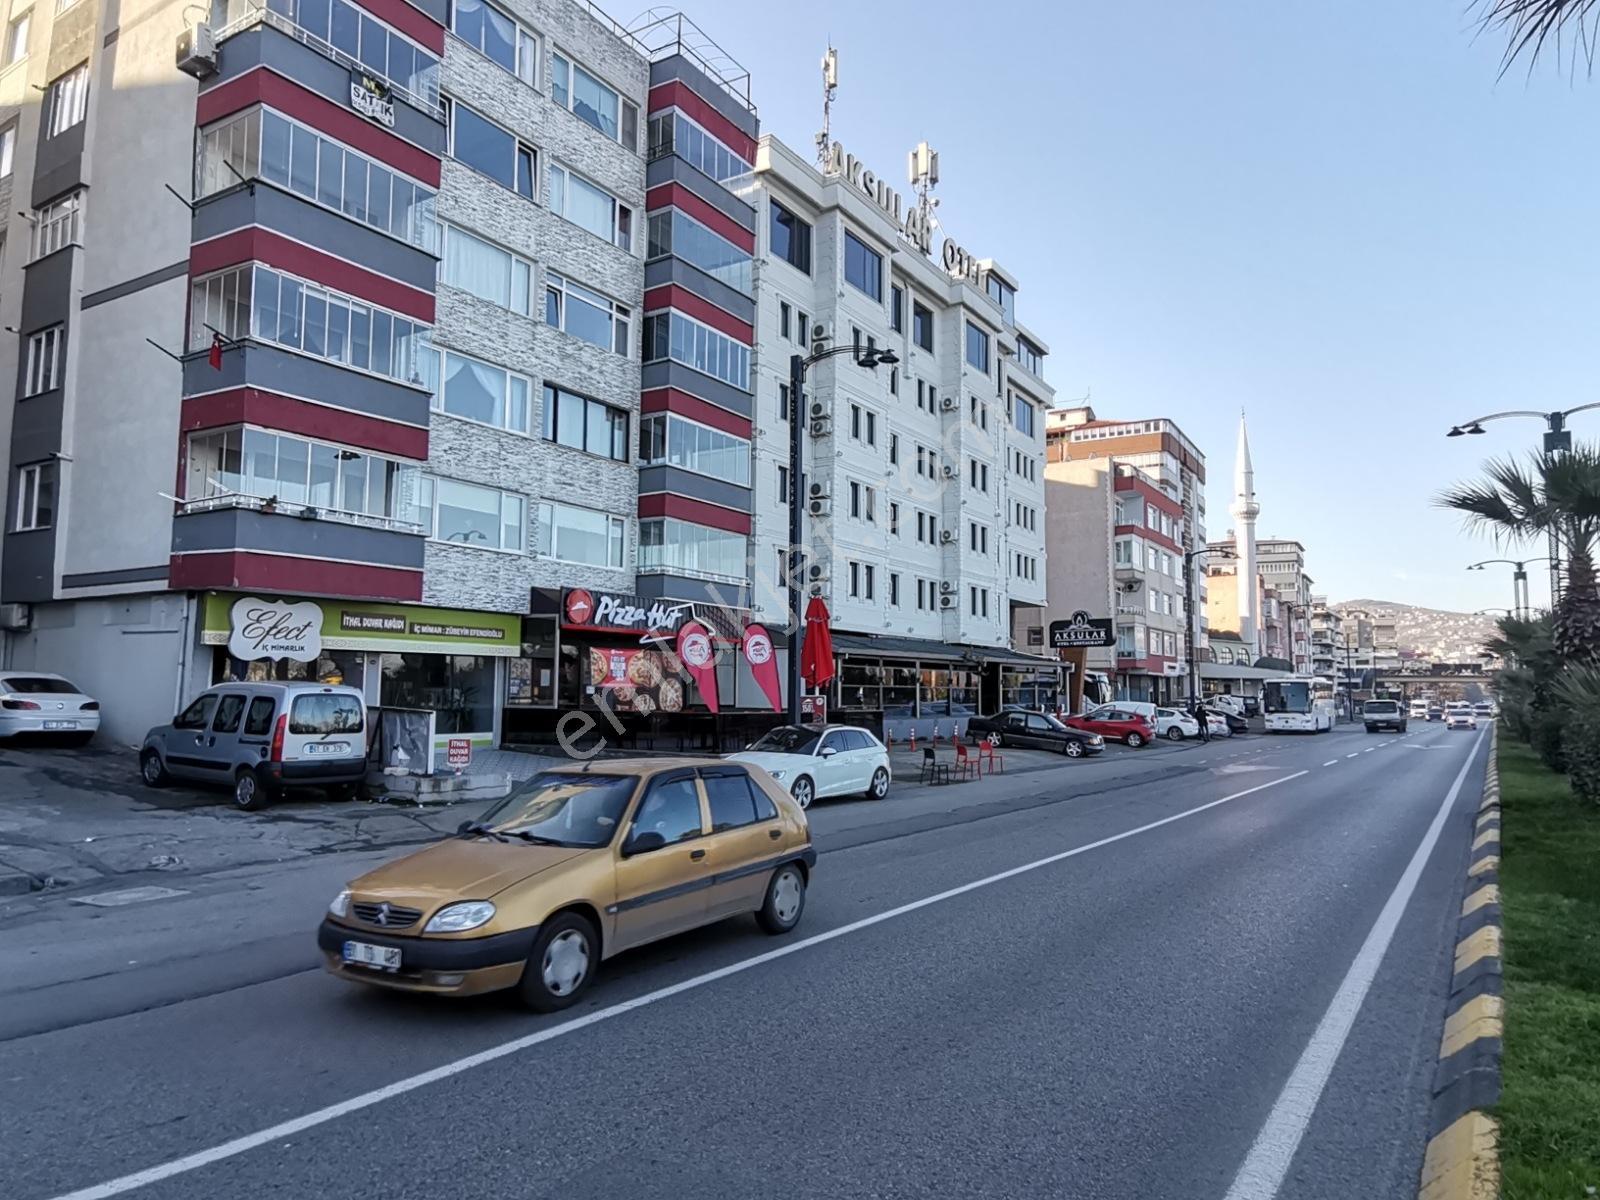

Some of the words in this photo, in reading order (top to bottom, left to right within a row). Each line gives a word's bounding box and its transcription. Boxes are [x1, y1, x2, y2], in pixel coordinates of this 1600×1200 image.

[830, 141, 934, 256] AKSULAR
[242, 608, 314, 650] Efect
[595, 595, 647, 626] Pizza
[646, 602, 683, 629] Hut
[1055, 631, 1106, 640] AKSULAR
